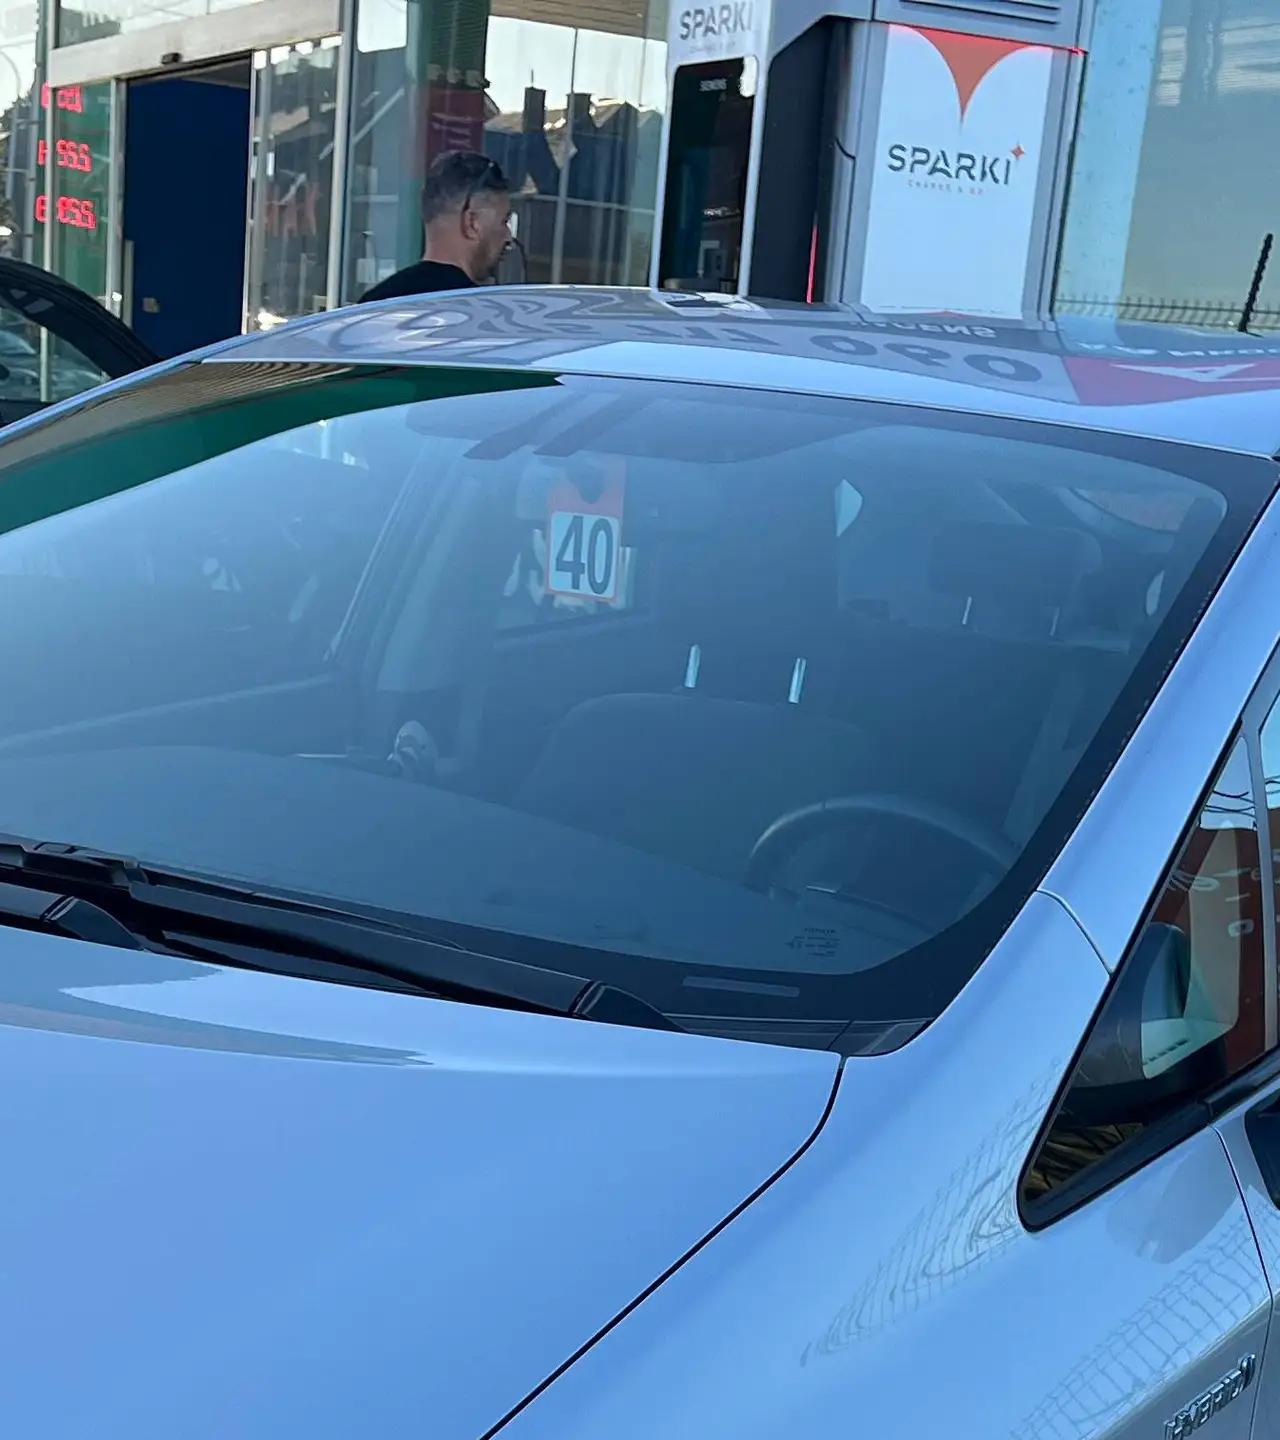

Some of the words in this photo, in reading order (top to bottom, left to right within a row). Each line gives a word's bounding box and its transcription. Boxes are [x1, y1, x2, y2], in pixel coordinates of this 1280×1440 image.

[680, 1, 753, 40] SPARKI
[888, 144, 1011, 185] SPARKI
[555, 515, 613, 594] 40
